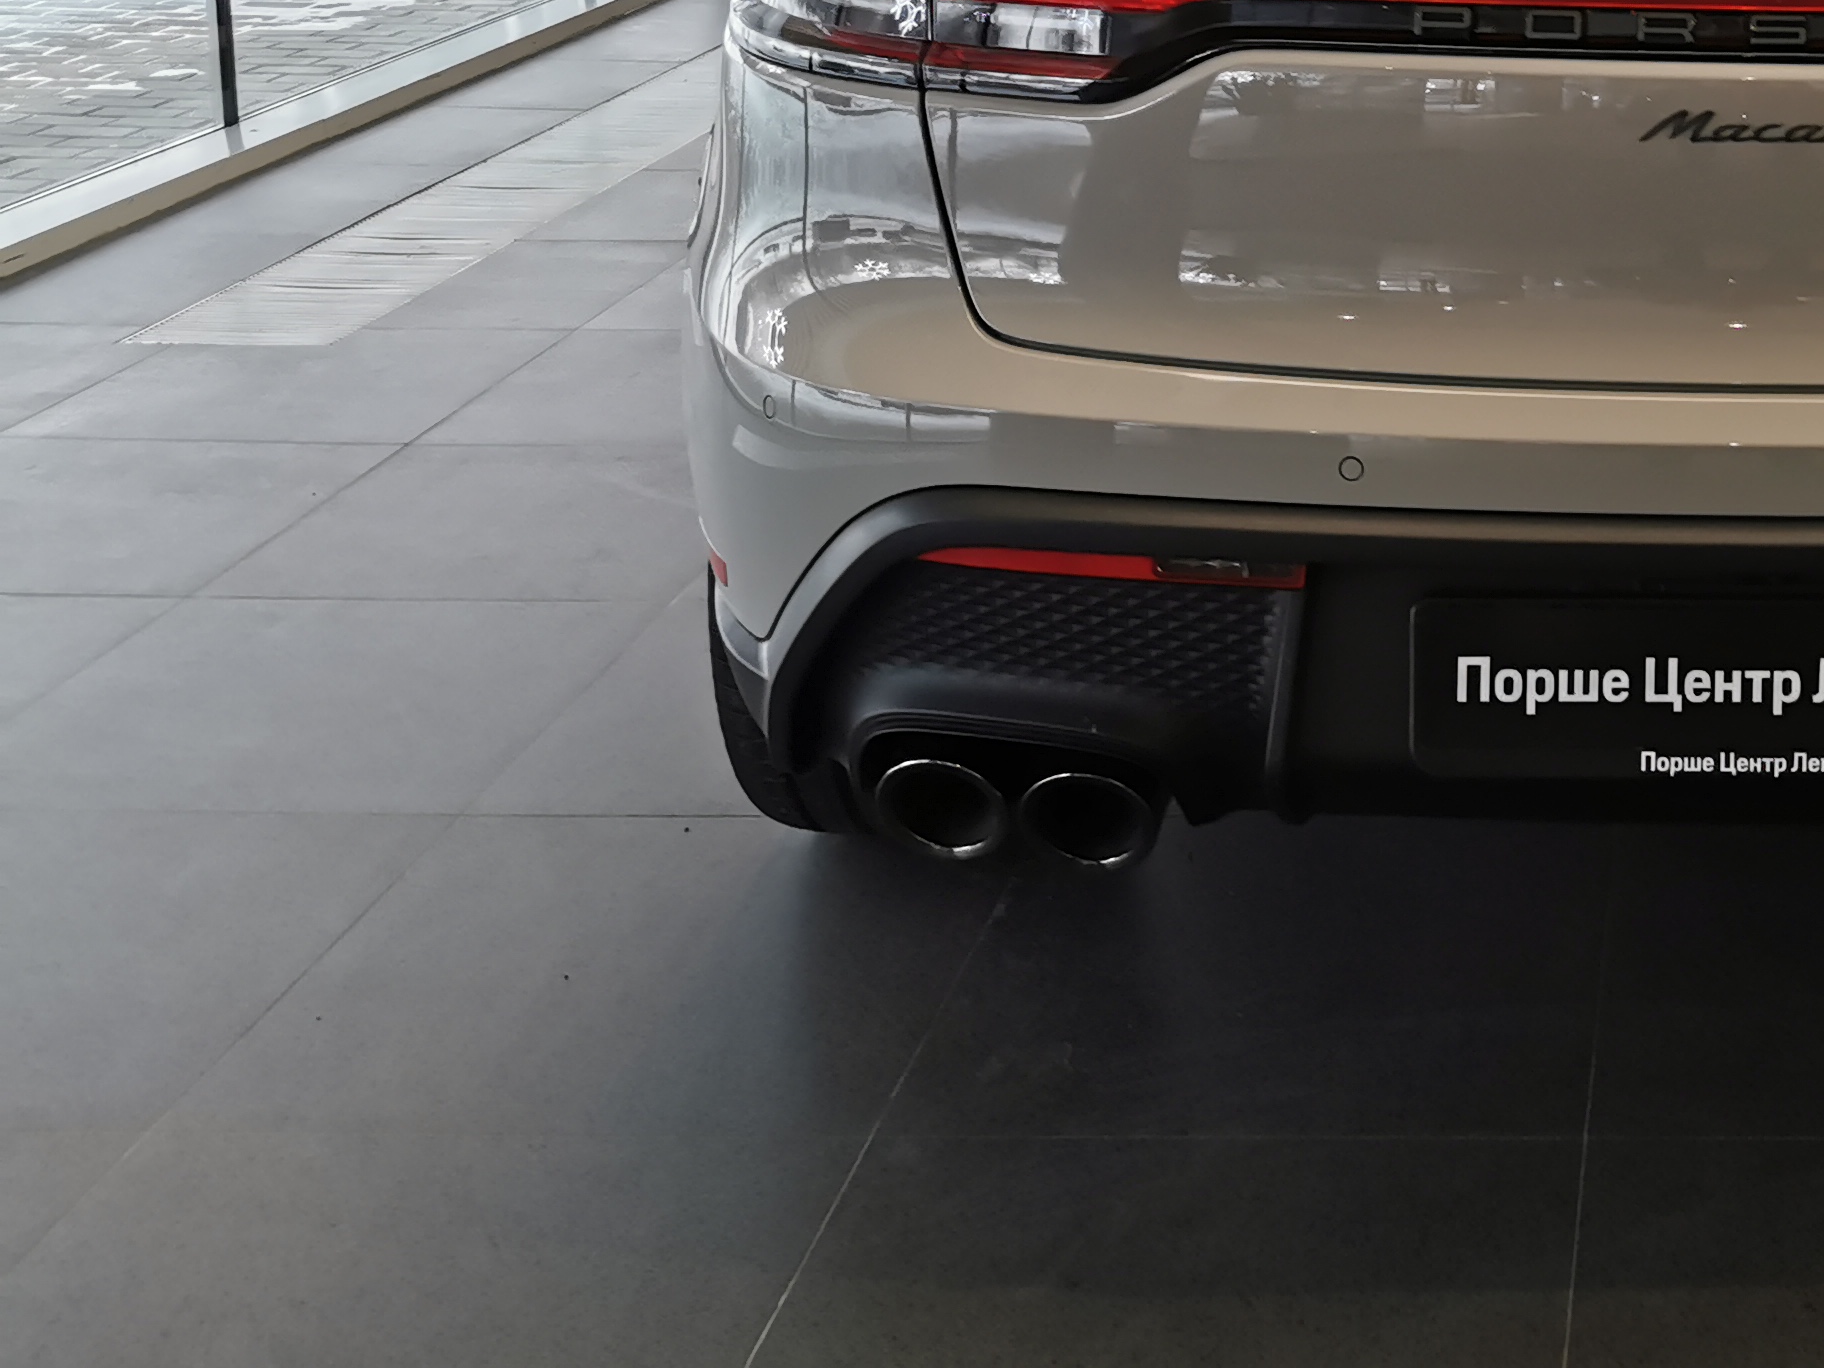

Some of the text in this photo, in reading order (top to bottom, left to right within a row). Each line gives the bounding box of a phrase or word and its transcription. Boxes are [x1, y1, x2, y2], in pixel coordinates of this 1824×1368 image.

[1456, 657, 1630, 715] Порше
[1644, 657, 1801, 715] Центр
[1640, 751, 1715, 777] Порше
[1719, 752, 1787, 777] Центр
